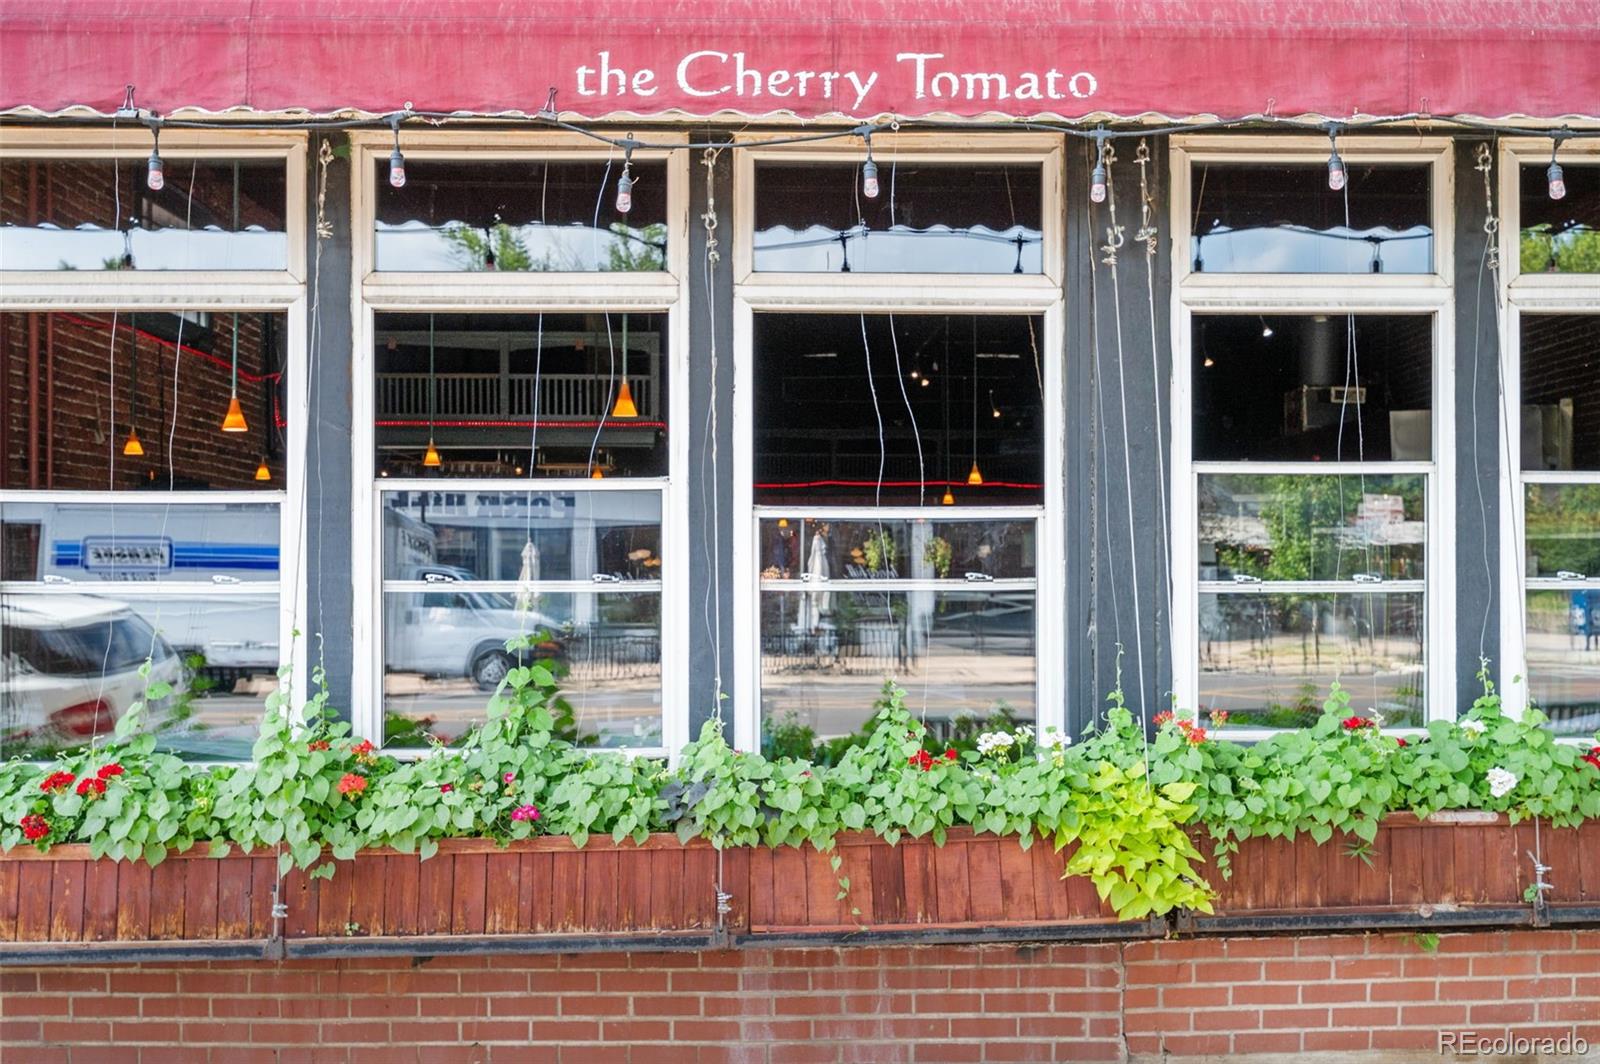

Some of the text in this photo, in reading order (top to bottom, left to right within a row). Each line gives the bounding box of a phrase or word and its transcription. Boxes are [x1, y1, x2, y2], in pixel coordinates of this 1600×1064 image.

[575, 50, 1098, 111] the Cherry Tomato
